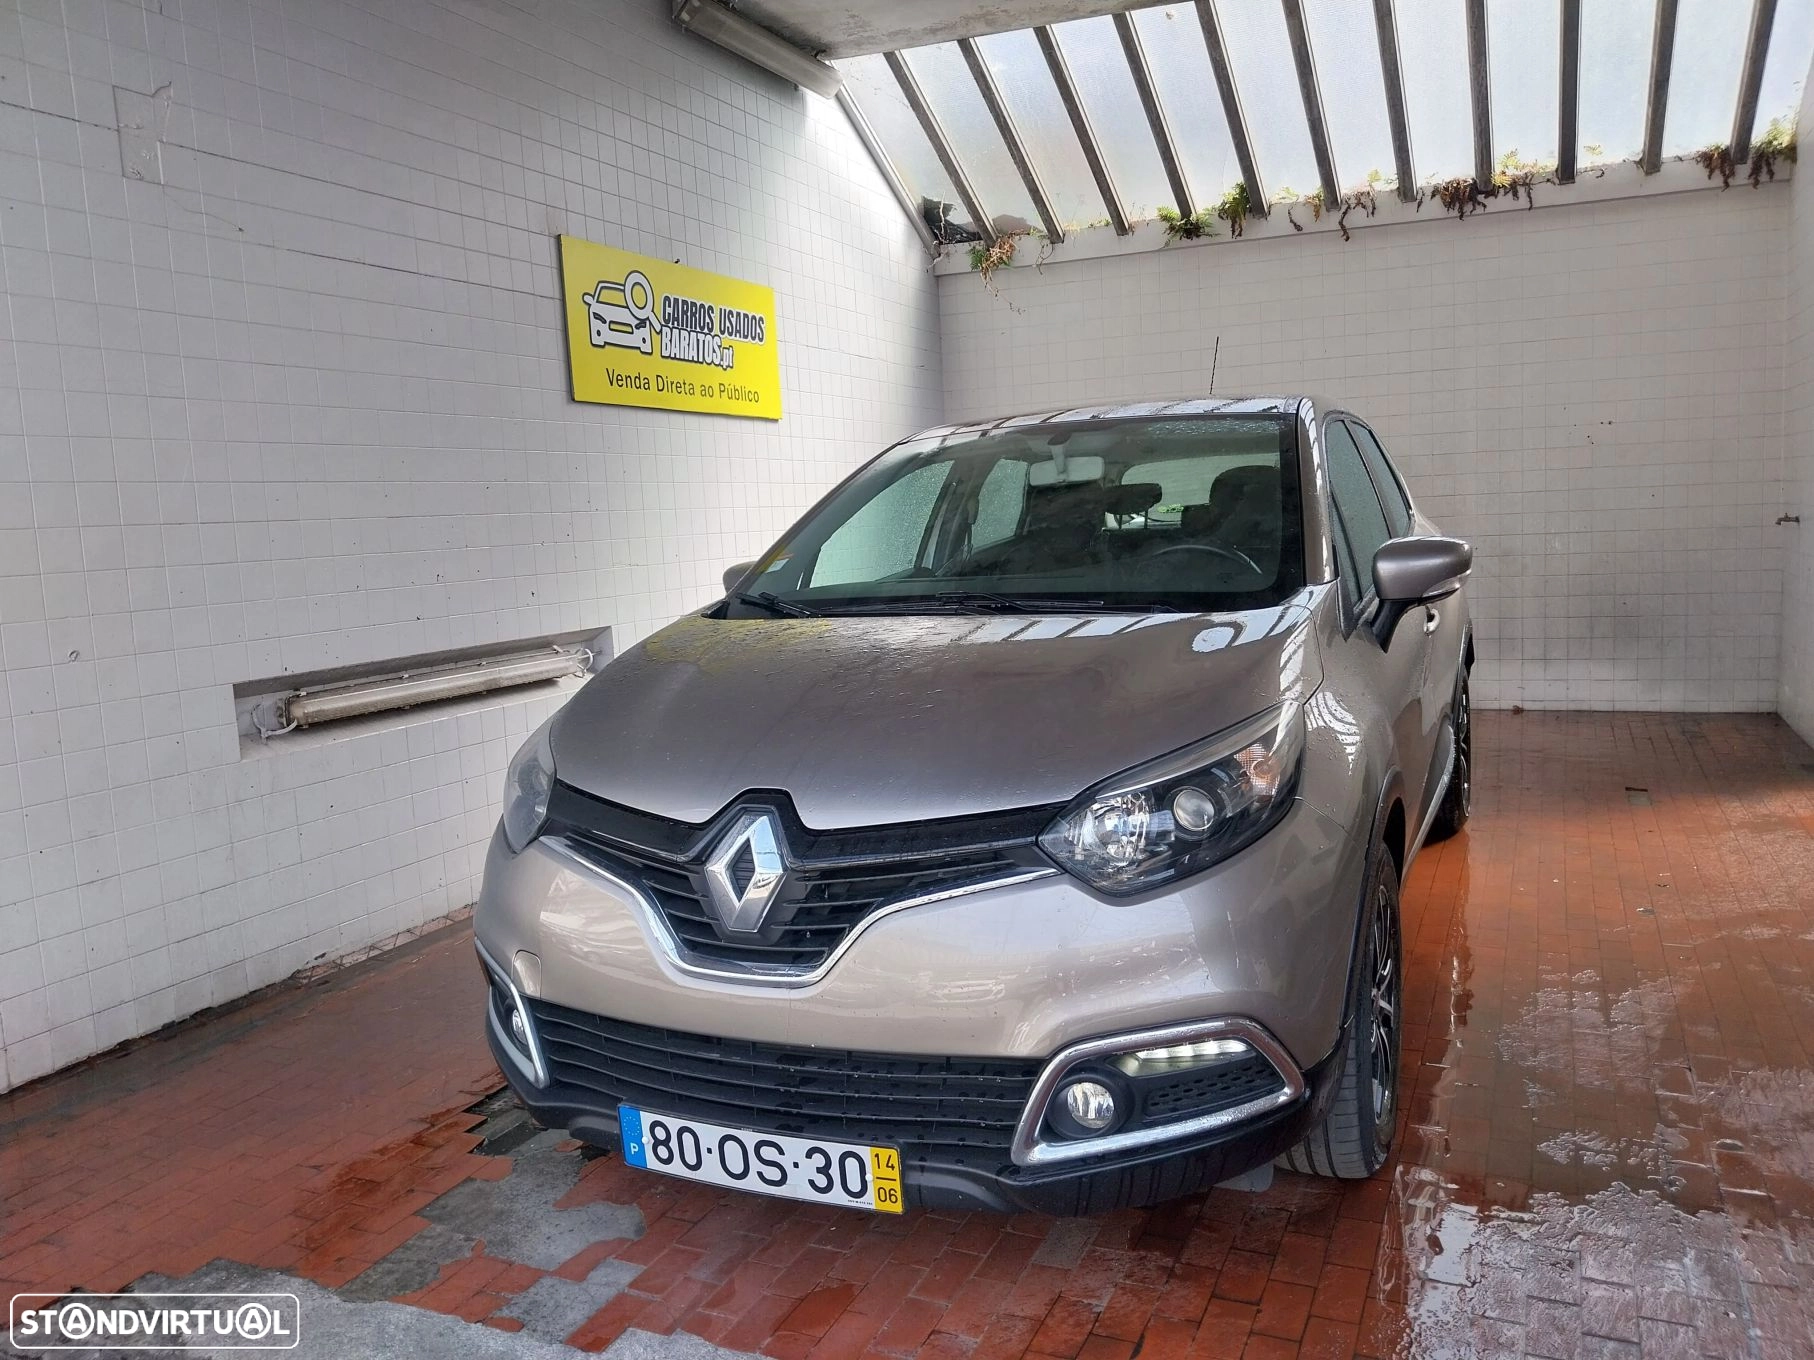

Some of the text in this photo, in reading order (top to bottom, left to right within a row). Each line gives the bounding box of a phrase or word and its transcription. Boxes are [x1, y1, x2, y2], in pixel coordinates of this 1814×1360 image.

[662, 295, 765, 343] CARROS USADOS
[661, 324, 733, 370] BARATOS.pt
[606, 368, 760, 403] Venda Direta ao Público
[631, 1143, 639, 1155] P
[874, 1152, 895, 1172] 14
[877, 1187, 899, 1204] 06
